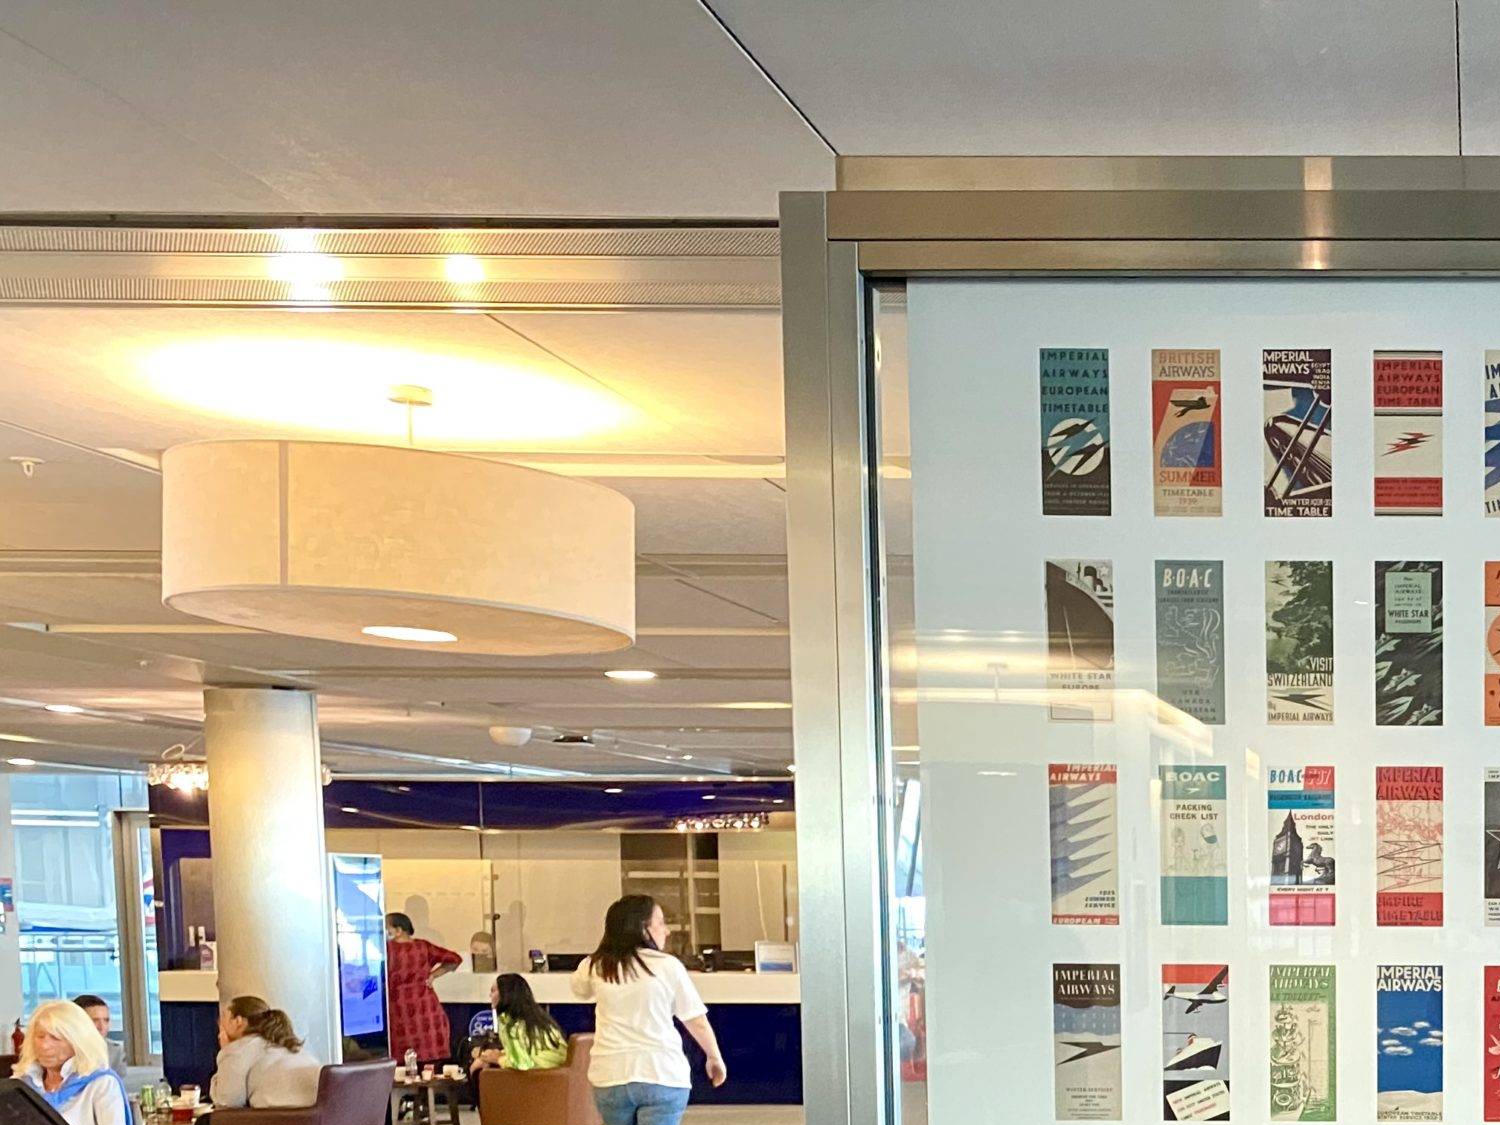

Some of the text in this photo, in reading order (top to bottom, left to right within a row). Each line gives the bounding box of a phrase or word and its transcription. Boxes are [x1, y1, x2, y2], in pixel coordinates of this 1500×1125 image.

[1041, 351, 1108, 361] IMPERIAL
[1159, 352, 1215, 364] BRITISH
[1263, 364, 1309, 374] AIRWAYS
[1376, 362, 1440, 371] IMPERIAL
[1042, 369, 1108, 378] AIRWAYS
[1159, 366, 1216, 378] AIRWAYS
[1377, 374, 1440, 383] AIRWAYS
[1042, 386, 1108, 396] EUROPEAN
[1377, 386, 1440, 395] EUROPEAN
[1043, 404, 1109, 413] TIMETABLE
[1160, 471, 1216, 482] SUMMER
[1163, 489, 1214, 497] TIMETABLE
[1267, 507, 1328, 516] TIME TABLE
[1388, 610, 1429, 618] WHITE STAR
[1310, 658, 1334, 672] VISIT
[1267, 673, 1333, 687] SWITZERLAND
[1269, 713, 1334, 722] IMPERIAL AIRWAYS
[1050, 772, 1101, 781] AIRWAYS
[1165, 771, 1220, 782] BOAC
[1377, 767, 1442, 783] IMPERIAL
[1376, 784, 1442, 800] AIRWAYS
[1294, 812, 1334, 821] London
[1055, 969, 1117, 981] IMPERIAL
[1270, 967, 1331, 977] IMPERIAL
[1377, 967, 1442, 979] IMPERIAL
[1060, 984, 1116, 995] AIRWAYS
[1377, 980, 1442, 991] AIRWAYS
